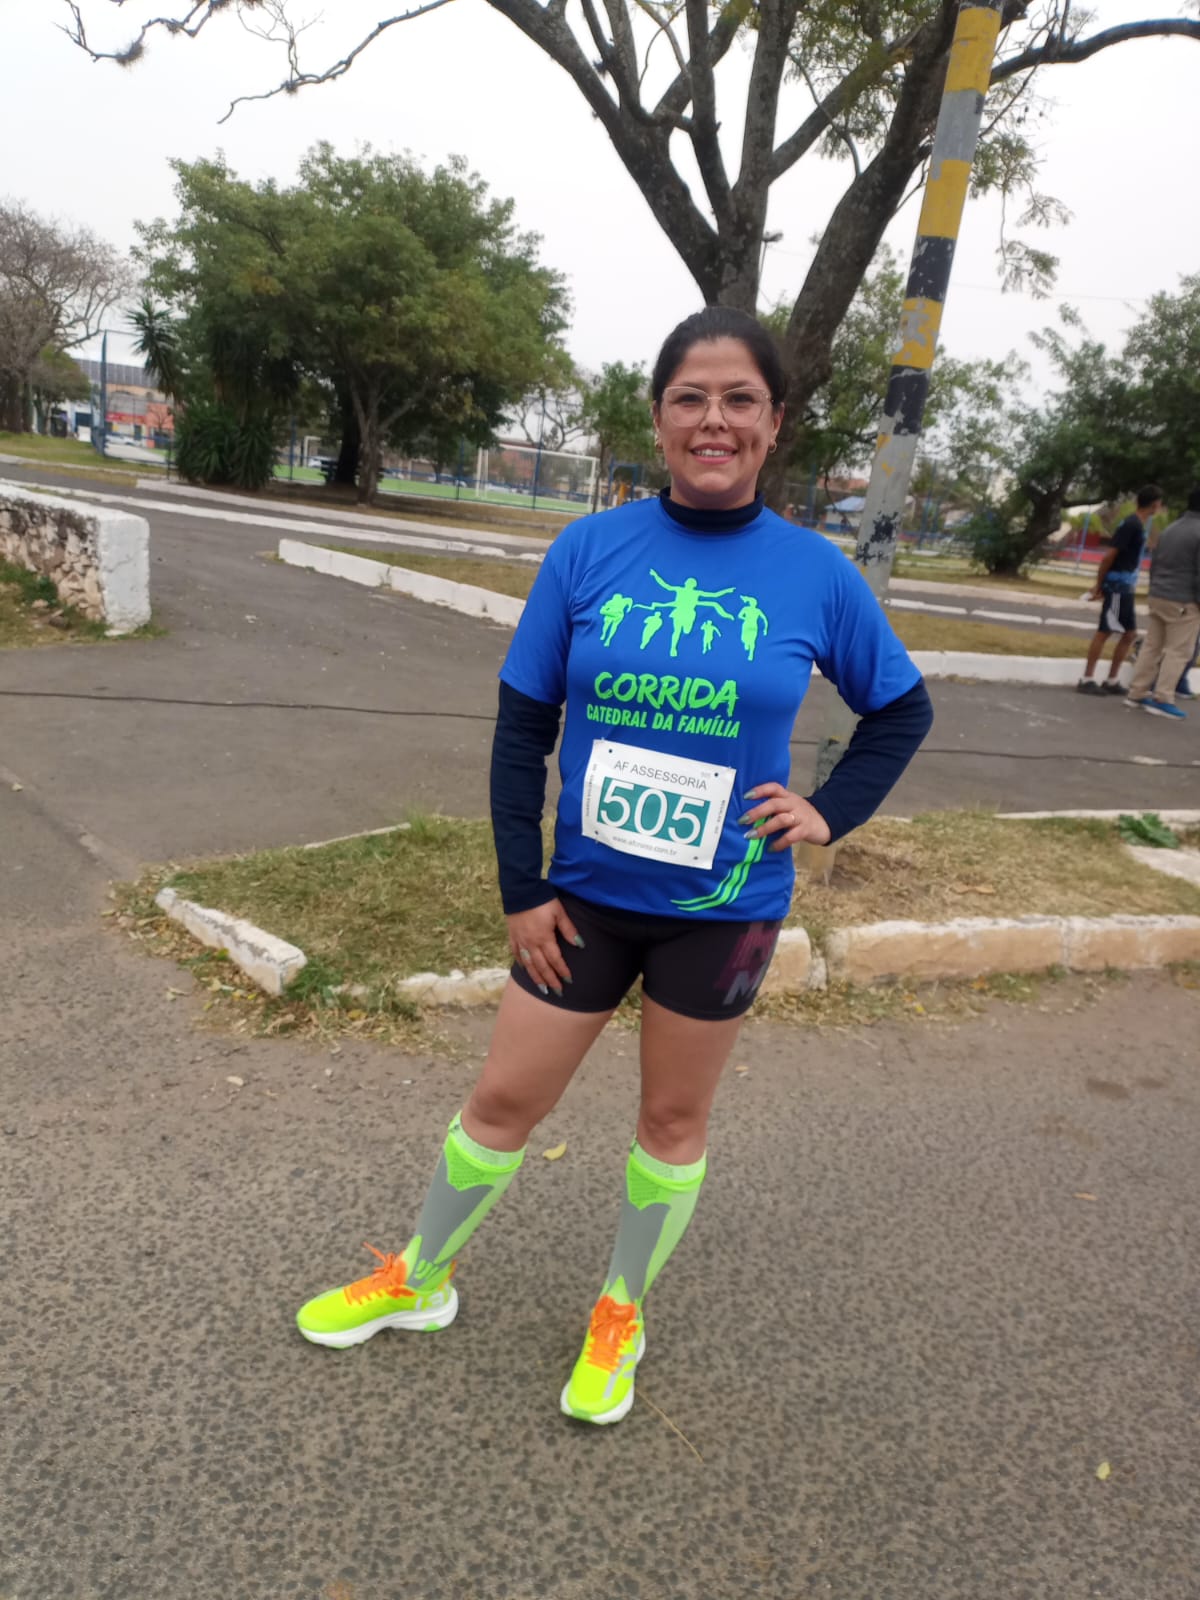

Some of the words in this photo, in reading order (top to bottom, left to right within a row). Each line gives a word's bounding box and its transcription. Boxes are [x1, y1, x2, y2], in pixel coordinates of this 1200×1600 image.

[594, 671, 739, 717] CORRIDA
[586, 703, 648, 728] CATEDRAL
[651, 712, 674, 731] DA
[677, 715, 741, 738] FAMÍLIA
[614, 760, 630, 772] AF
[630, 765, 708, 790] ASSESSORIA
[600, 779, 705, 845] 505
